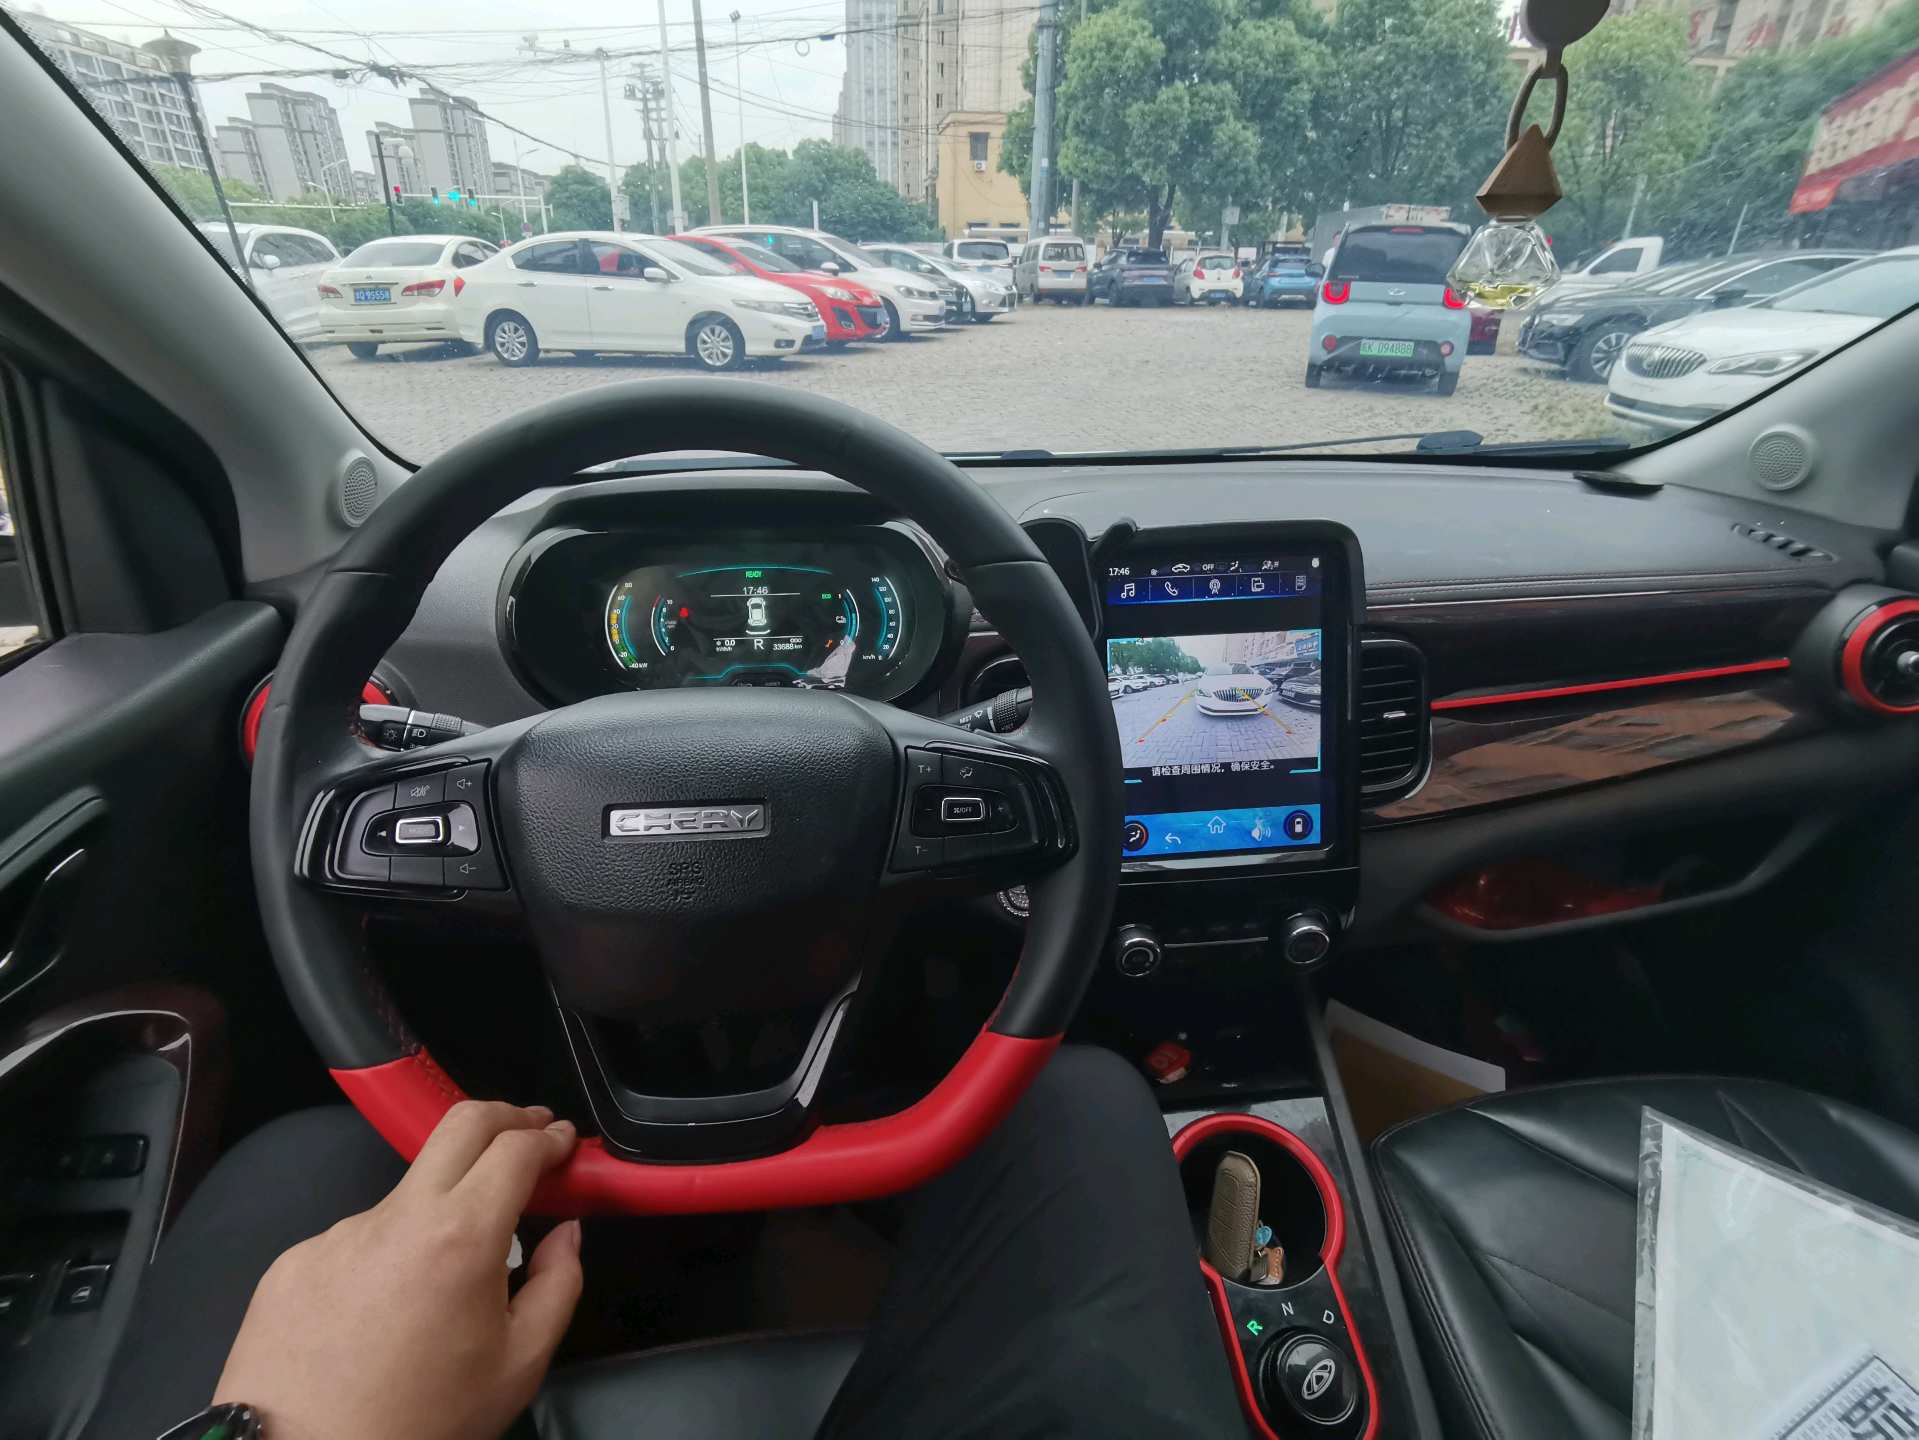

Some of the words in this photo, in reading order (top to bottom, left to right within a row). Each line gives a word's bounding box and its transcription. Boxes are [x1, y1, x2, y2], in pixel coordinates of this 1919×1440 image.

[1109, 566, 1130, 576] 17:46
[1202, 563, 1215, 571] OFF
[742, 586, 769, 595] 17:46
[754, 638, 765, 650] R
[615, 808, 760, 833] CHERY
[1281, 1301, 1294, 1316] N
[1323, 1310, 1335, 1324] D
[1247, 1320, 1263, 1336] R
